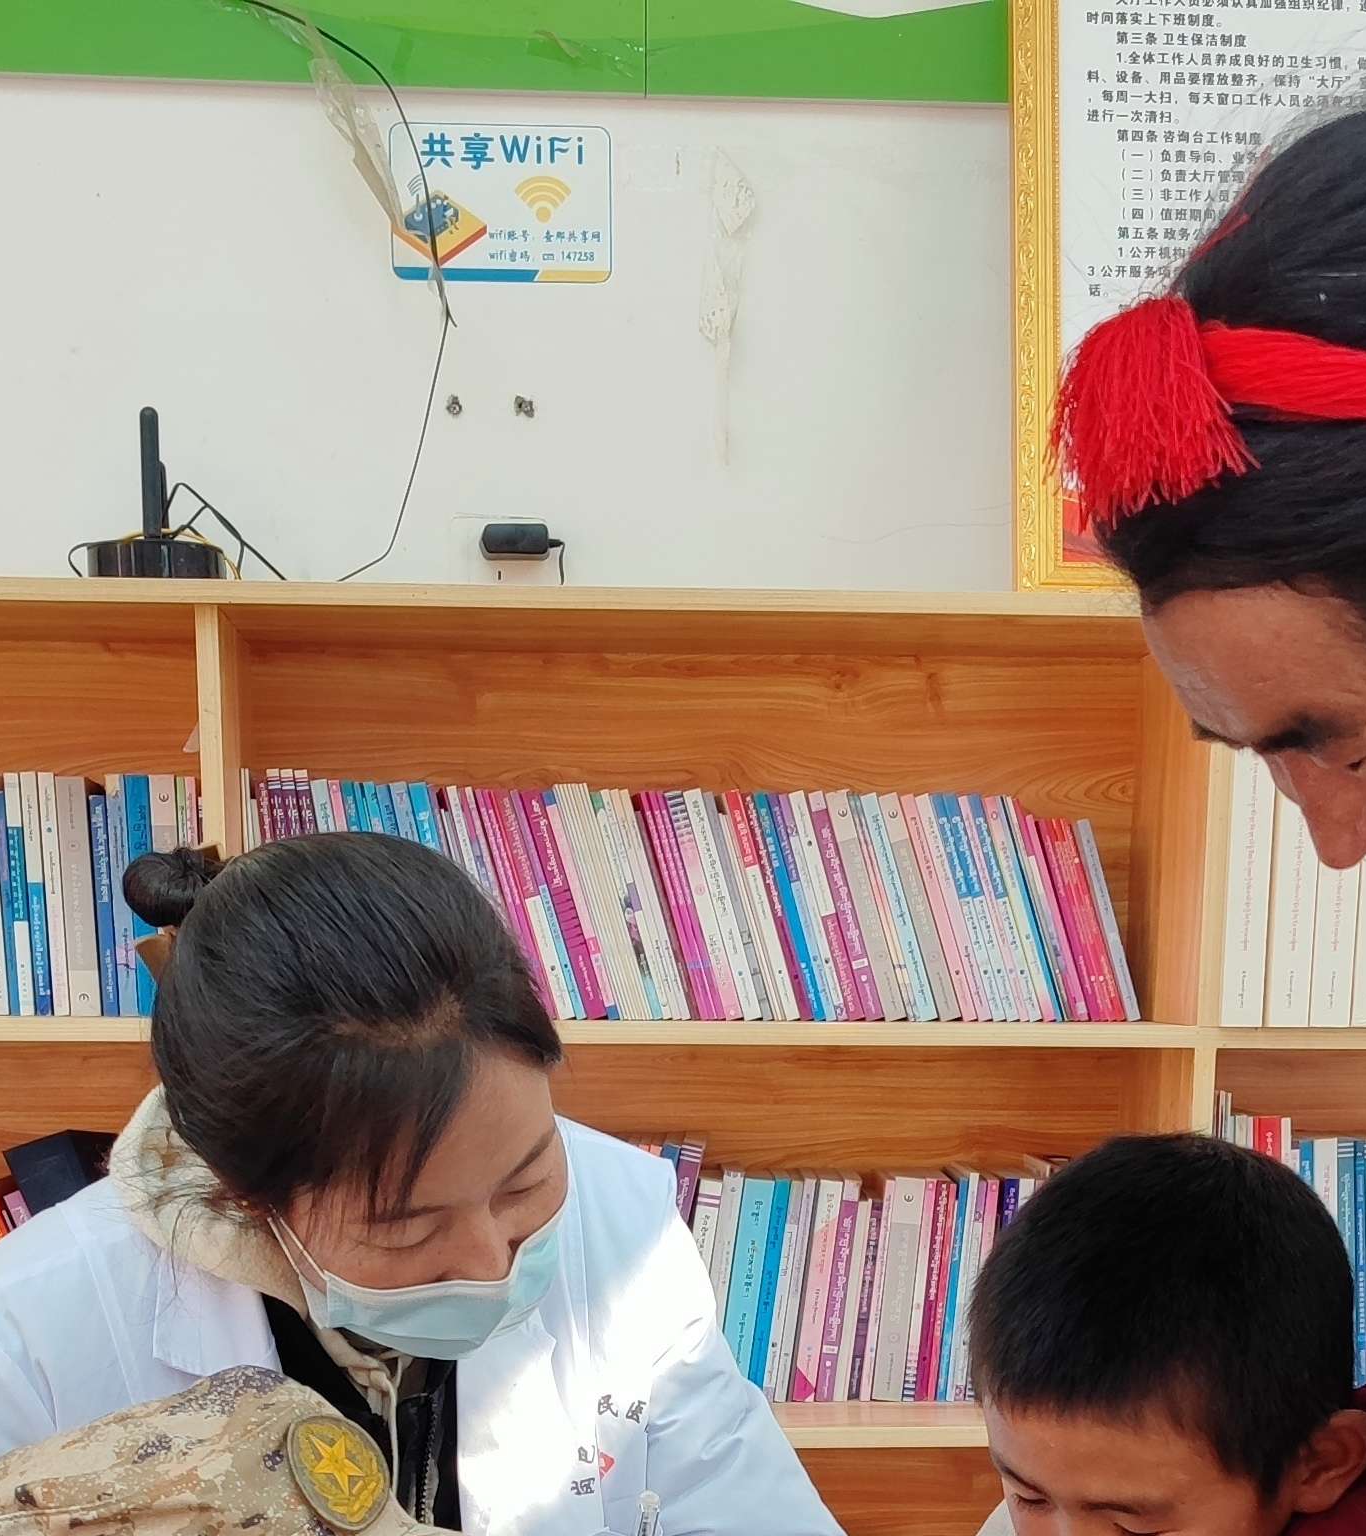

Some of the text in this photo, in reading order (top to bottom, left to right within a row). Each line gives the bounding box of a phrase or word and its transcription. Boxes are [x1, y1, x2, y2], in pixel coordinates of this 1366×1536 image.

[1086, 12, 1223, 28] 时间落实上下班制度。
[1116, 31, 1247, 48] 第三条 卫生保洁制度
[1086, 109, 1180, 124] 进行一次清扫。
[1116, 129, 1262, 145] 第四条 咨询台工作制度
[420, 132, 584, 169] 共享WiFi
[1117, 227, 1159, 240] 第五条
[1129, 246, 1192, 260] 公开机构
